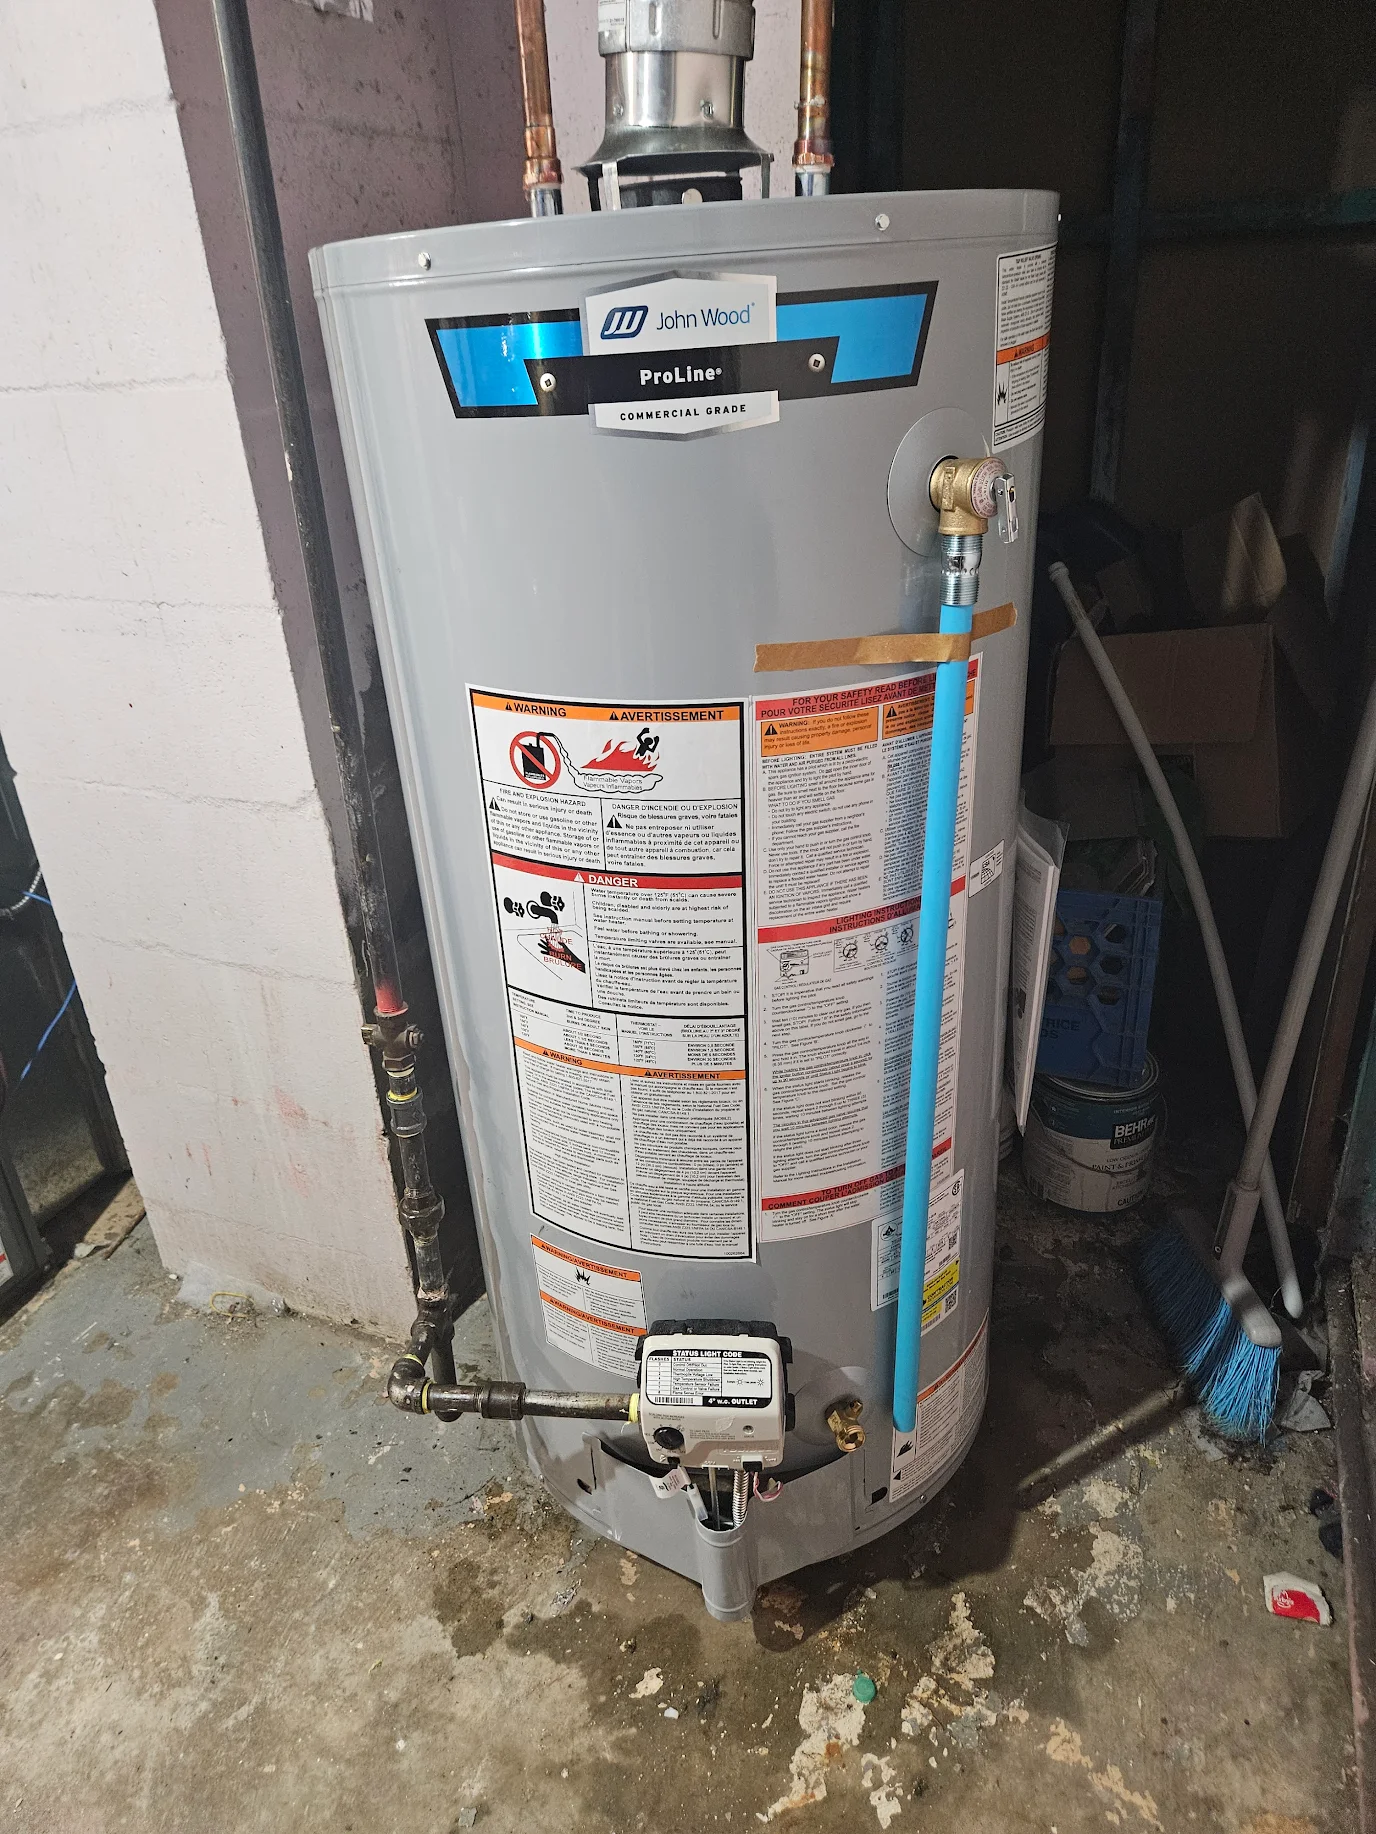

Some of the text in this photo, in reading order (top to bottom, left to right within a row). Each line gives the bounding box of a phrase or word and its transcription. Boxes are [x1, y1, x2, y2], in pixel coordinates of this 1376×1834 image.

[656, 305, 750, 331] John Wood
[620, 405, 746, 421] COMMERCIAL GRADE
[793, 697, 811, 706] FOR
[814, 694, 838, 704] YOUR
[841, 688, 873, 701] SAFETY
[875, 684, 896, 695] READ
[899, 676, 927, 691] BEFORE
[514, 702, 724, 722] WARNING AVERTISSEMENT
[761, 709, 786, 718] POUR
[788, 705, 817, 715] VOTRE
[861, 695, 882, 705] LISEZ
[883, 692, 907, 702] AVANT
[811, 731, 831, 739] property
[853, 724, 871, 732] personal
[500, 788, 586, 807] FIRE AND EXPLOSION HAZARD
[507, 798, 522, 806] result
[529, 802, 549, 810] serious
[550, 806, 566, 814] injury
[575, 808, 592, 816] death
[693, 803, 738, 811] D'EXPLOSION
[549, 815, 572, 824] gasoline
[588, 874, 638, 888] DANGER
[607, 889, 639, 897] temperature
[604, 914, 632, 922] instruction
[836, 896, 921, 925] LIGHTING INSTRUCTION
[829, 915, 886, 933] INSTRUCTIONS
[549, 1051, 582, 1065] WARNING
[652, 1071, 720, 1079] AVERTISSEMENT
[1115, 1119, 1148, 1138] BEHR
[833, 1184, 852, 1194] TURN
[855, 1179, 868, 1187] OFF
[869, 1174, 883, 1184] GAS
[768, 1178, 884, 1210] COMMENT COUPER L'ADMISSION
[545, 1246, 628, 1278] WARNING/AVERTISSEMENT
